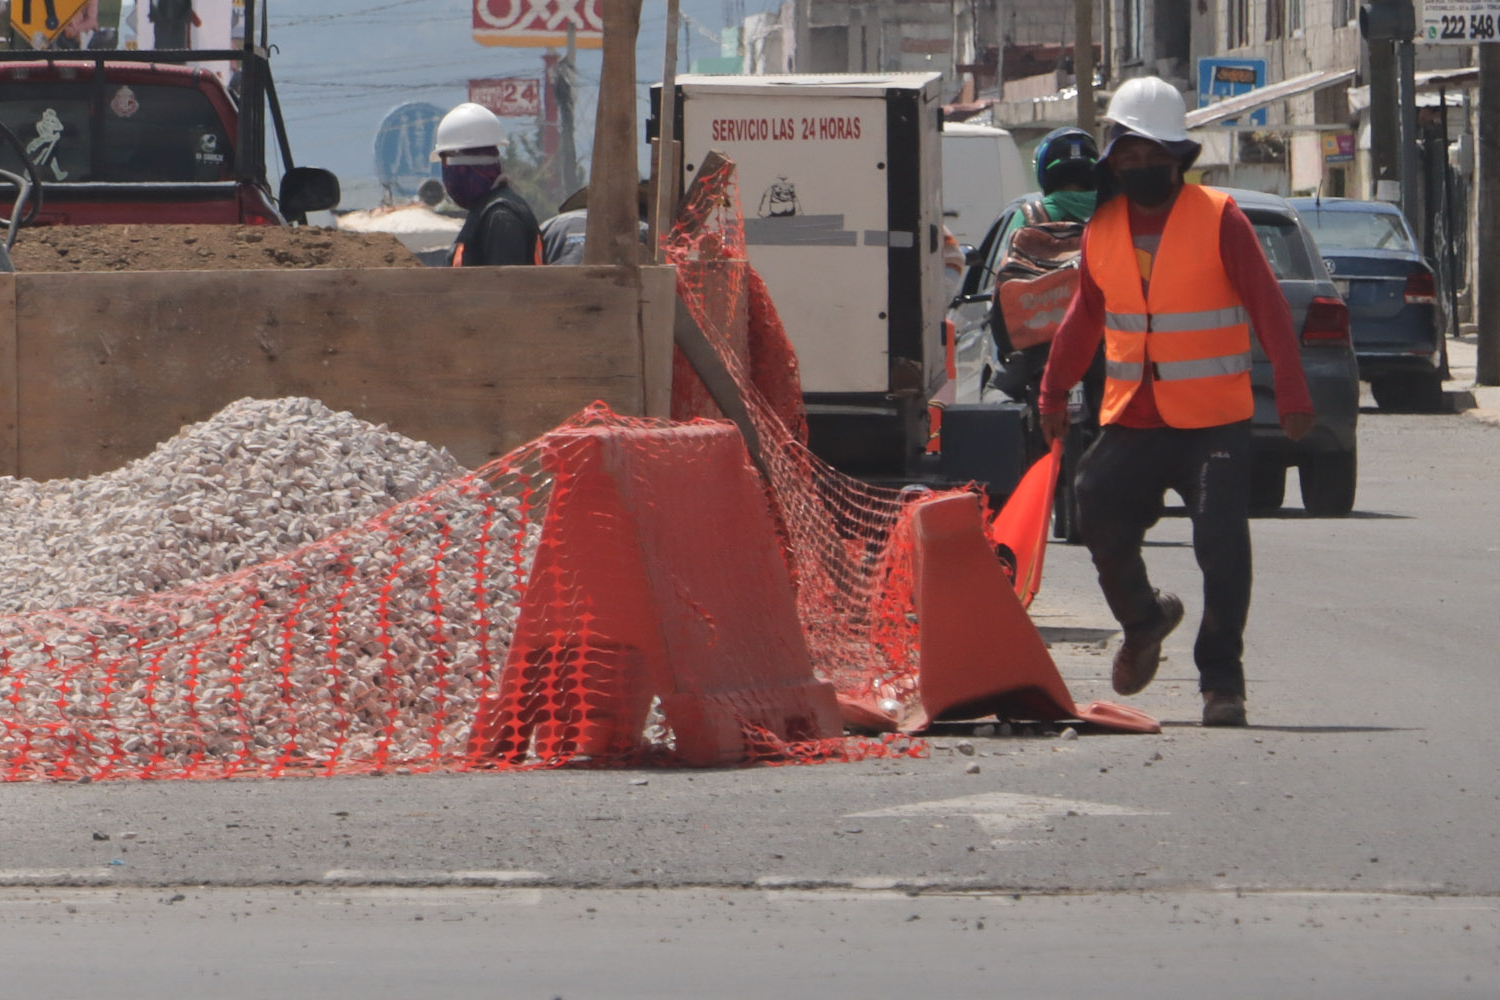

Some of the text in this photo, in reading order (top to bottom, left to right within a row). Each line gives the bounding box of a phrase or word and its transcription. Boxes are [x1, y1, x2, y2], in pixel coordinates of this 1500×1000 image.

[1441, 14, 1495, 39] 222 548
[504, 84, 539, 104] 24
[712, 116, 861, 142] SERVICIO LAS 24 HORAS
